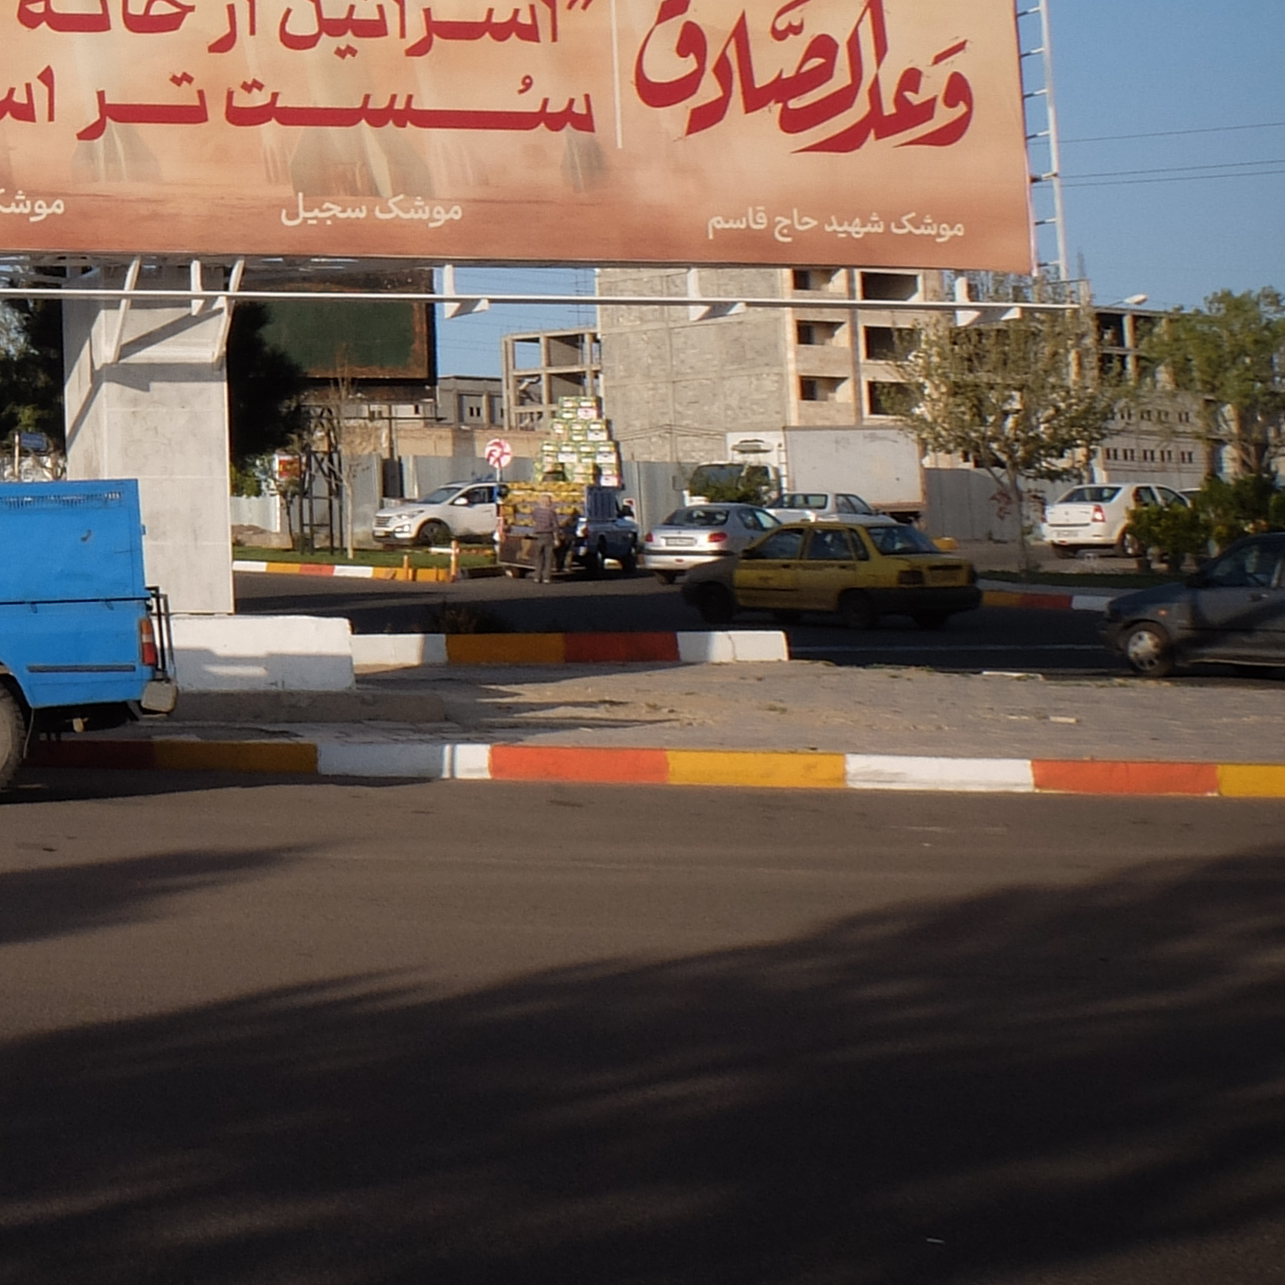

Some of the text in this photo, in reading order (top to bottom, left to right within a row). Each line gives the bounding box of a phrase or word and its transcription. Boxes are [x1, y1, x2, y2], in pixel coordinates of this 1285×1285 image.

[76, 71, 209, 141] تر
[280, 191, 463, 229] موشک سجیل
[707, 205, 965, 243] موشک شهید حاج قاسم
